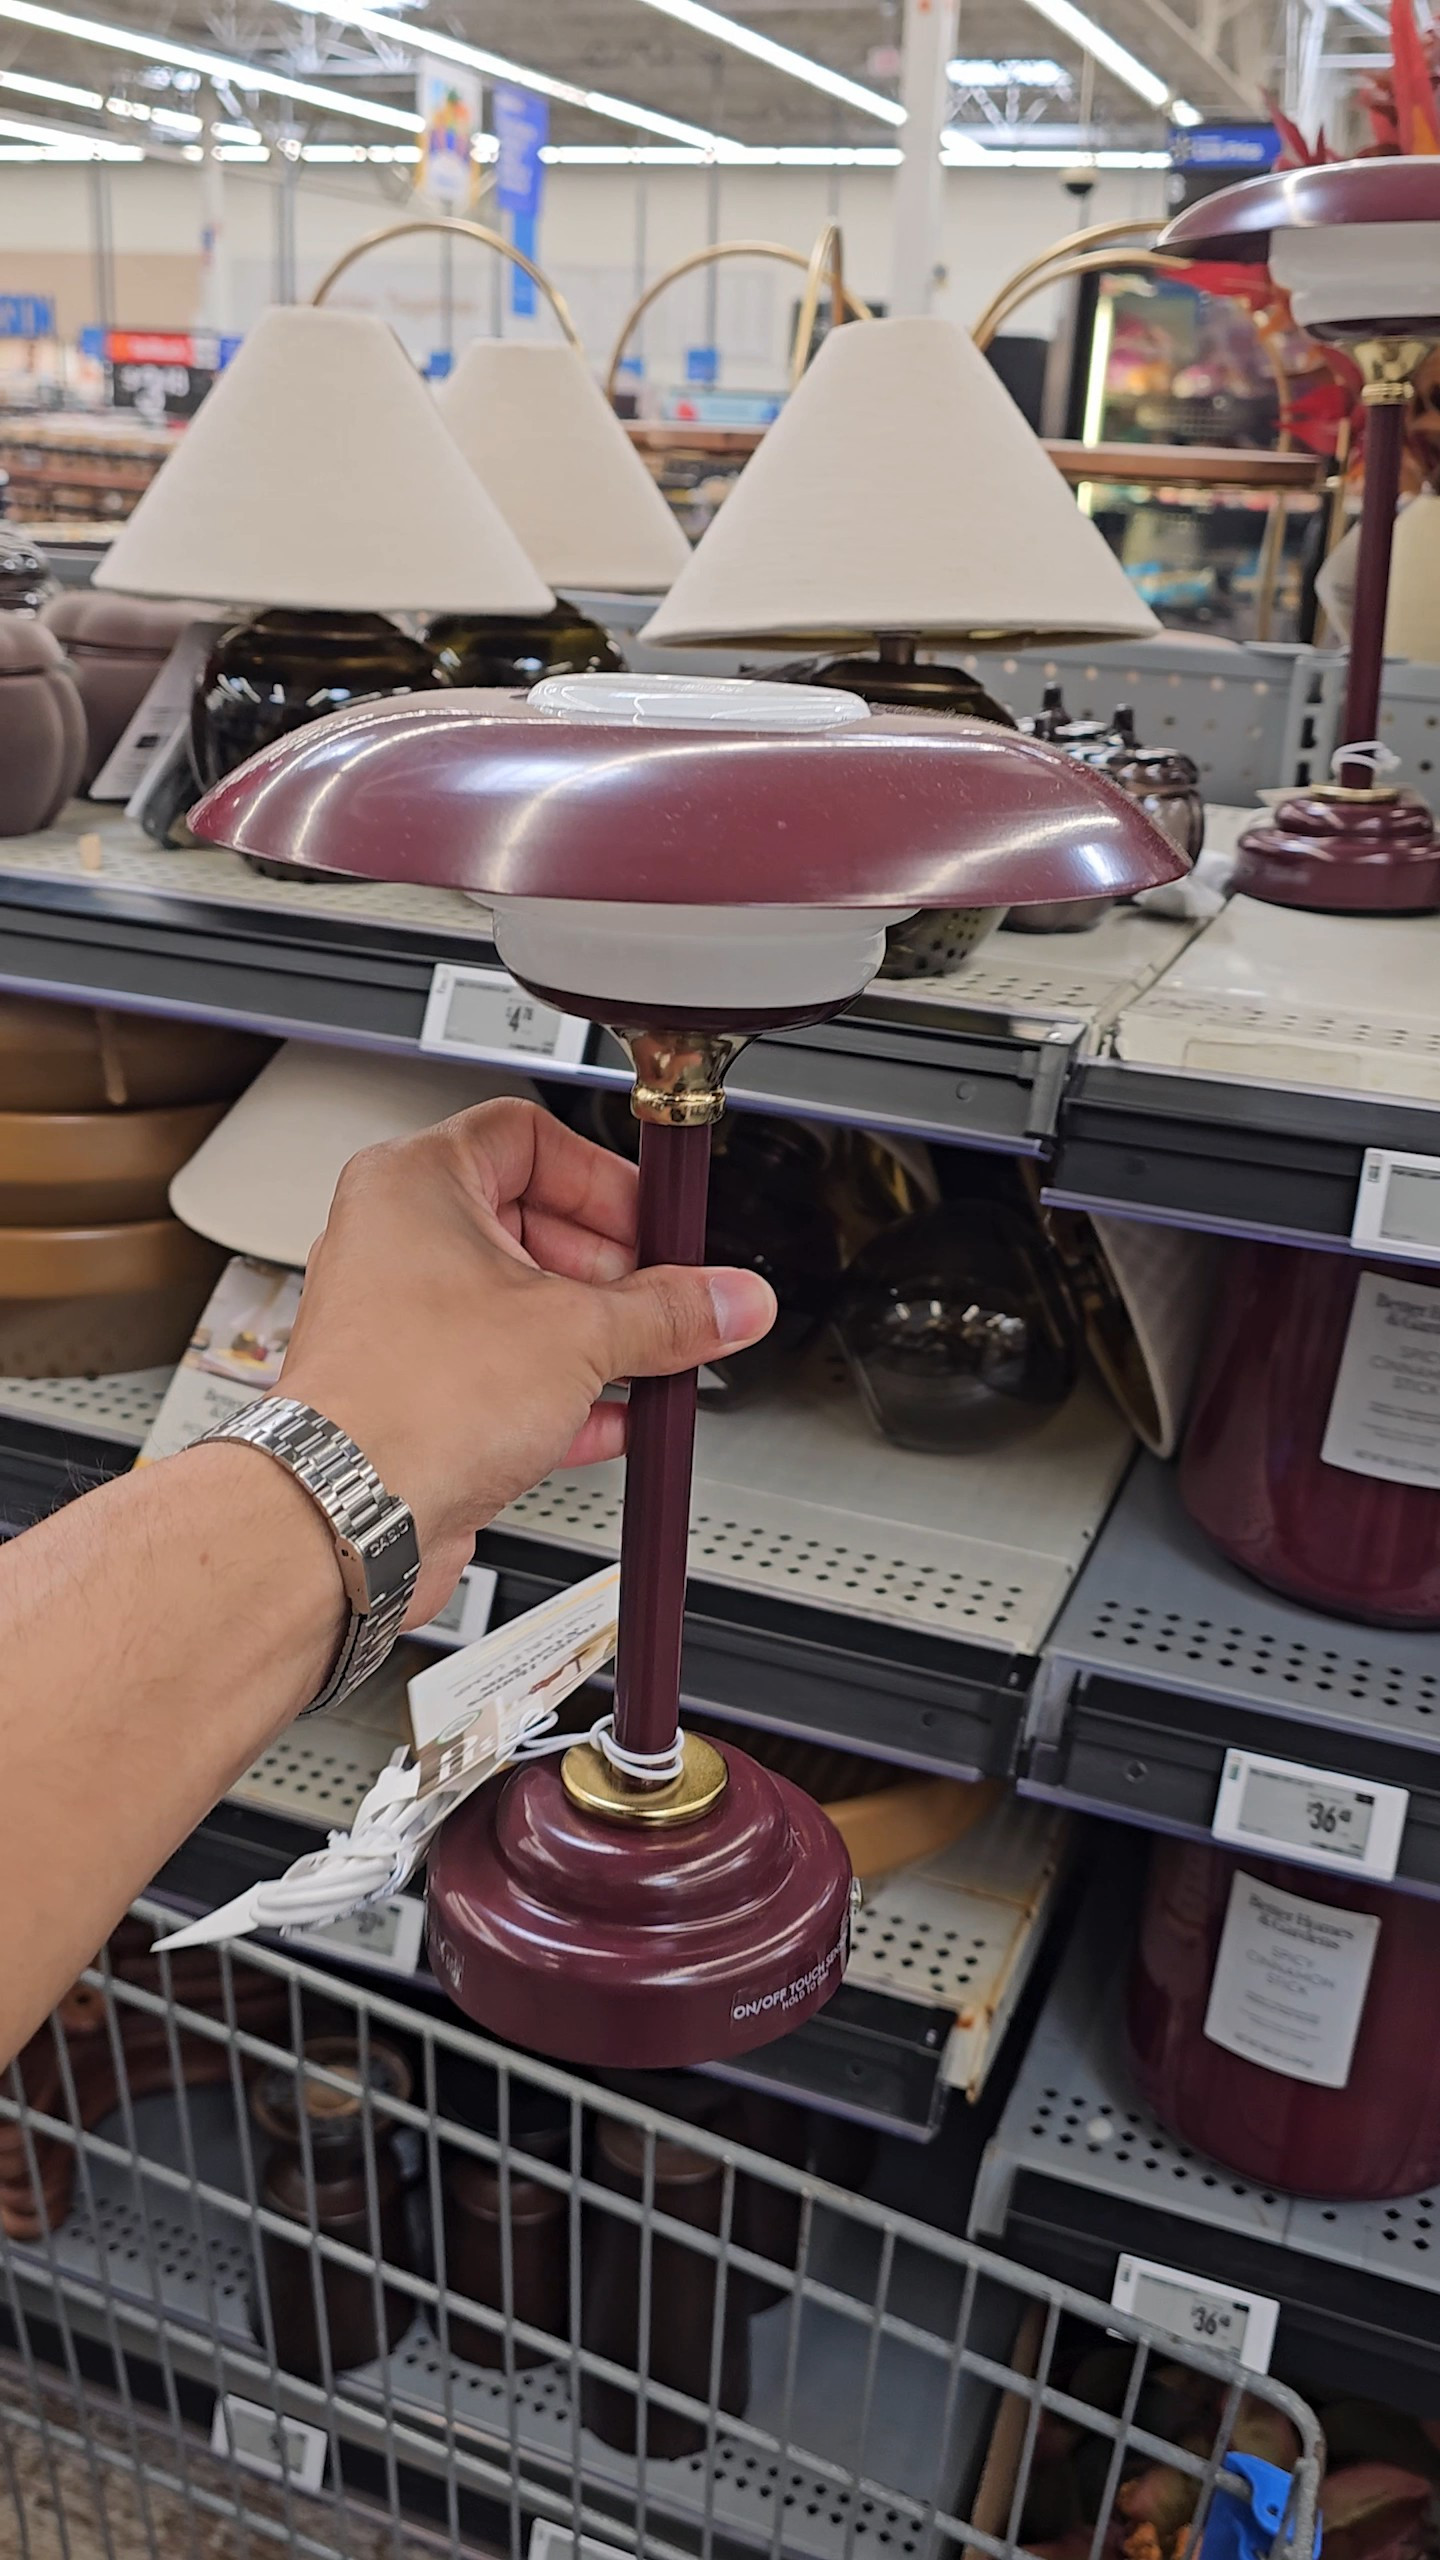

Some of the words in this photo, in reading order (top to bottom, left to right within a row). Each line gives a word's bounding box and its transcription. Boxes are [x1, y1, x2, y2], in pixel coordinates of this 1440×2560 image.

[369, 1519, 410, 1558] CASIO
[733, 1987, 788, 2020] ON/OFF
[788, 1963, 826, 1996] TOUCH
